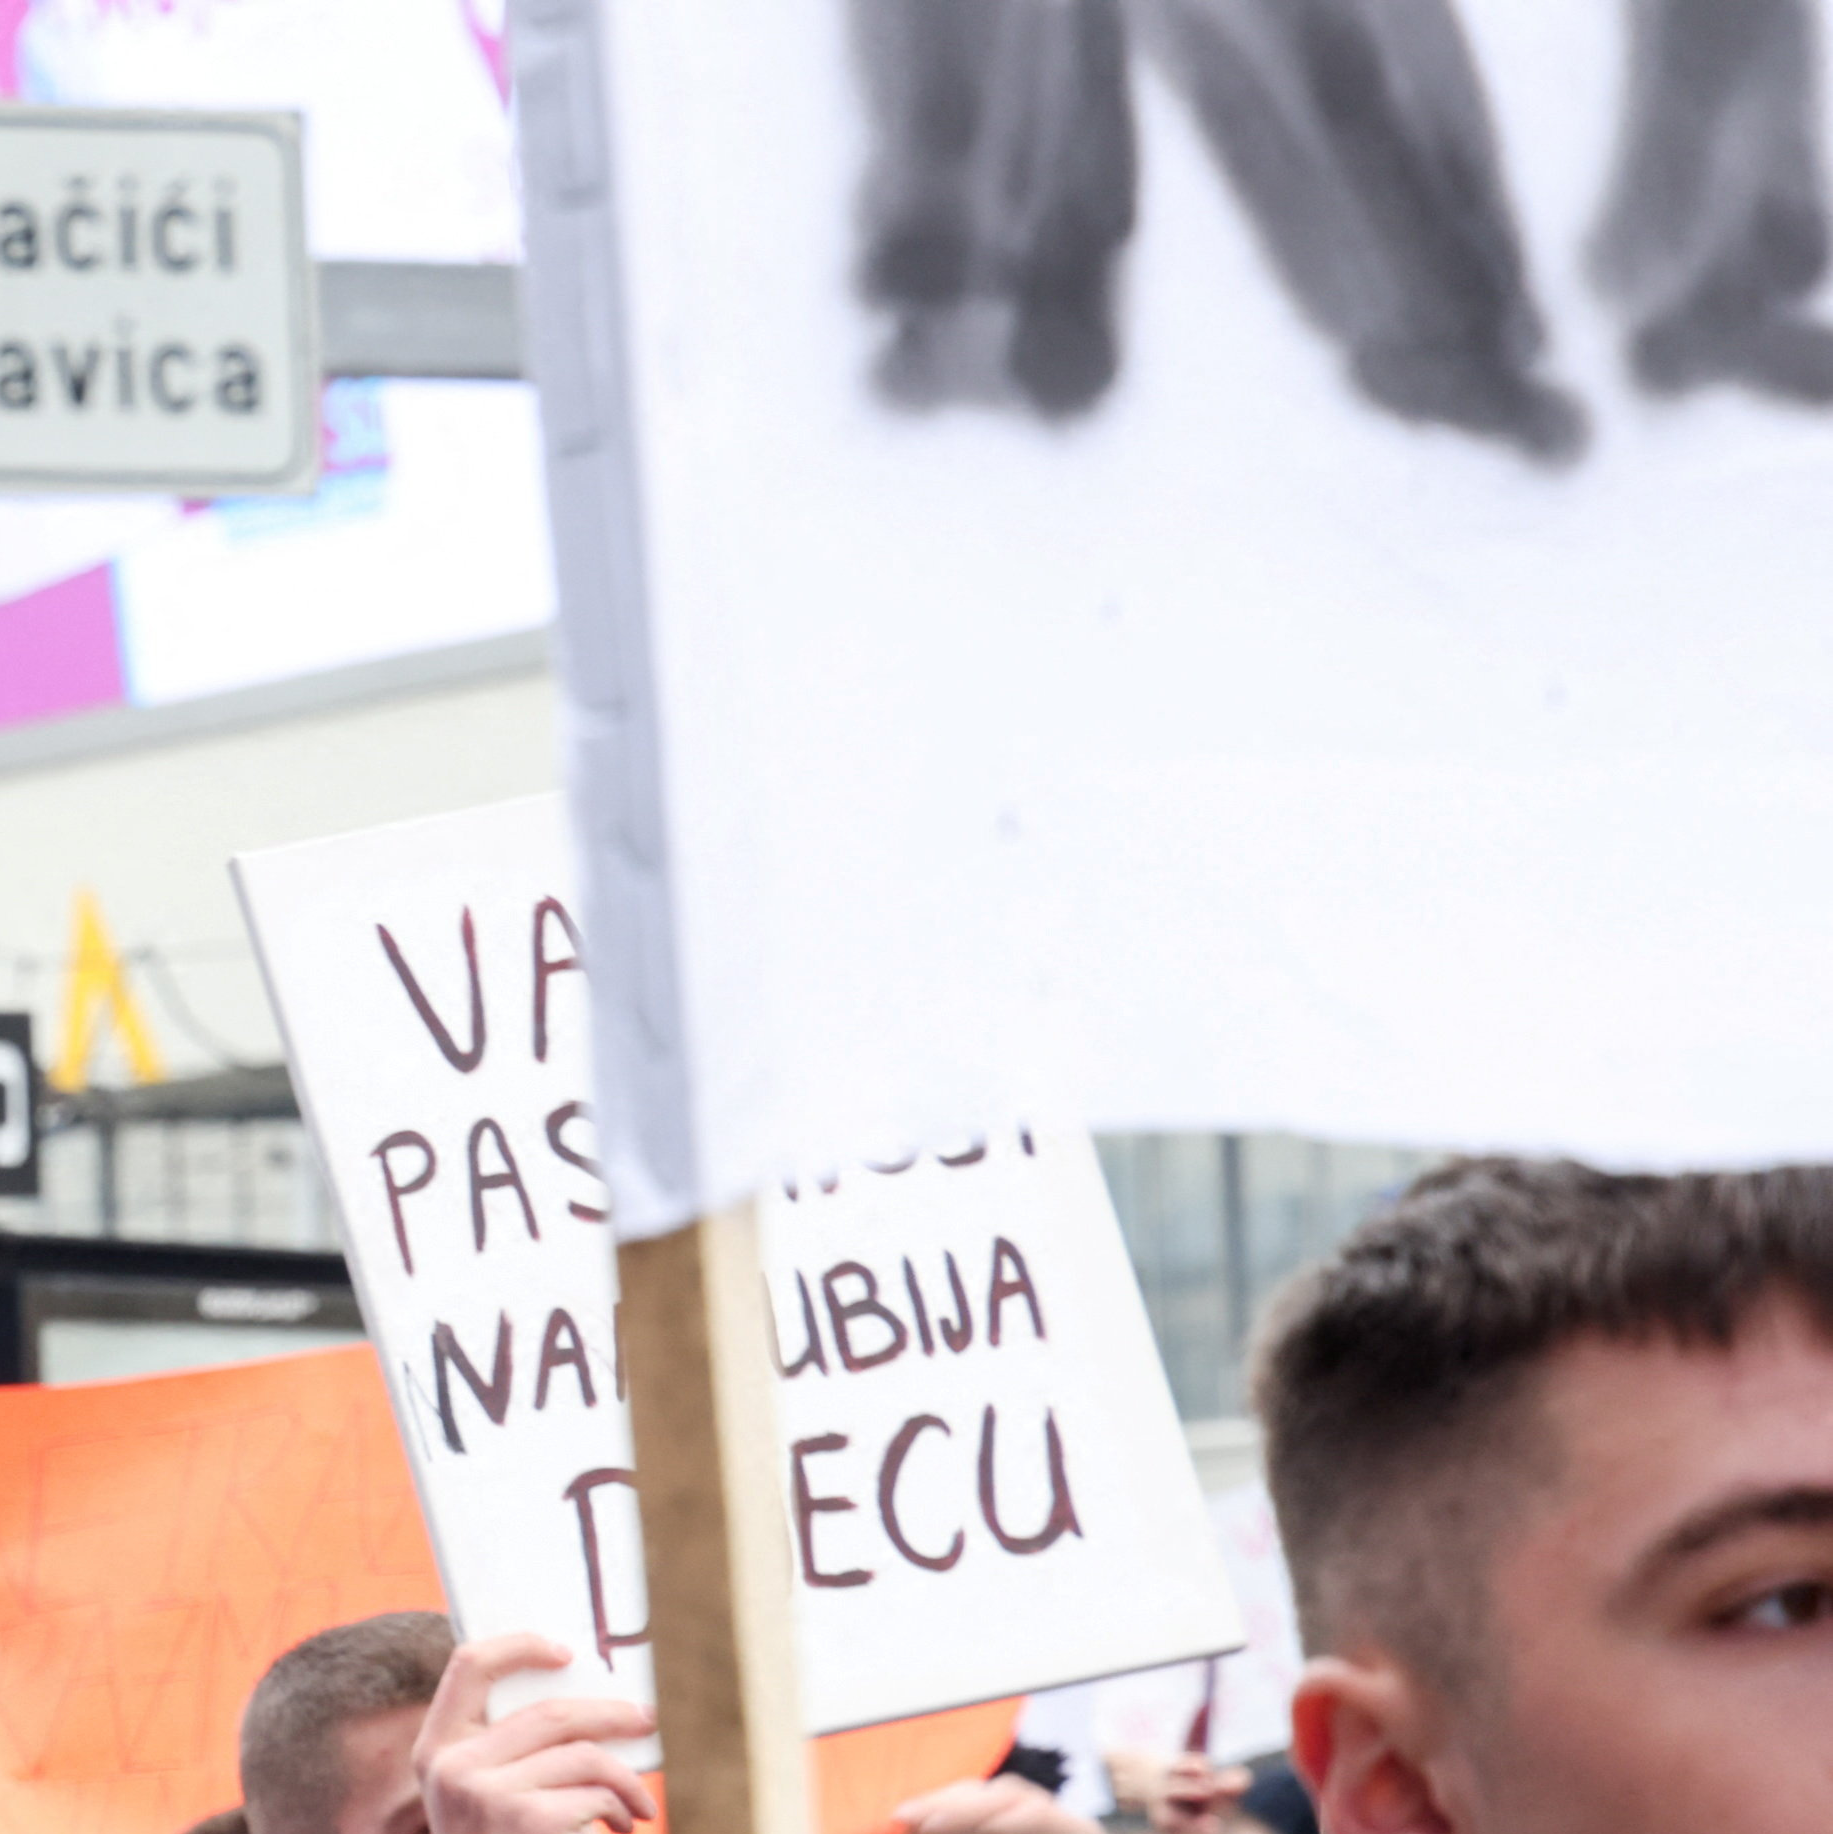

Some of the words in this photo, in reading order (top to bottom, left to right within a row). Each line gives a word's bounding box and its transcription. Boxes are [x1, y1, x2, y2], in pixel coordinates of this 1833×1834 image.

[376, 893, 587, 1074] VA
[430, 1305, 628, 1455] NA
[765, 1236, 1047, 1378] UBIJA
[563, 1403, 1083, 1672] DECU
